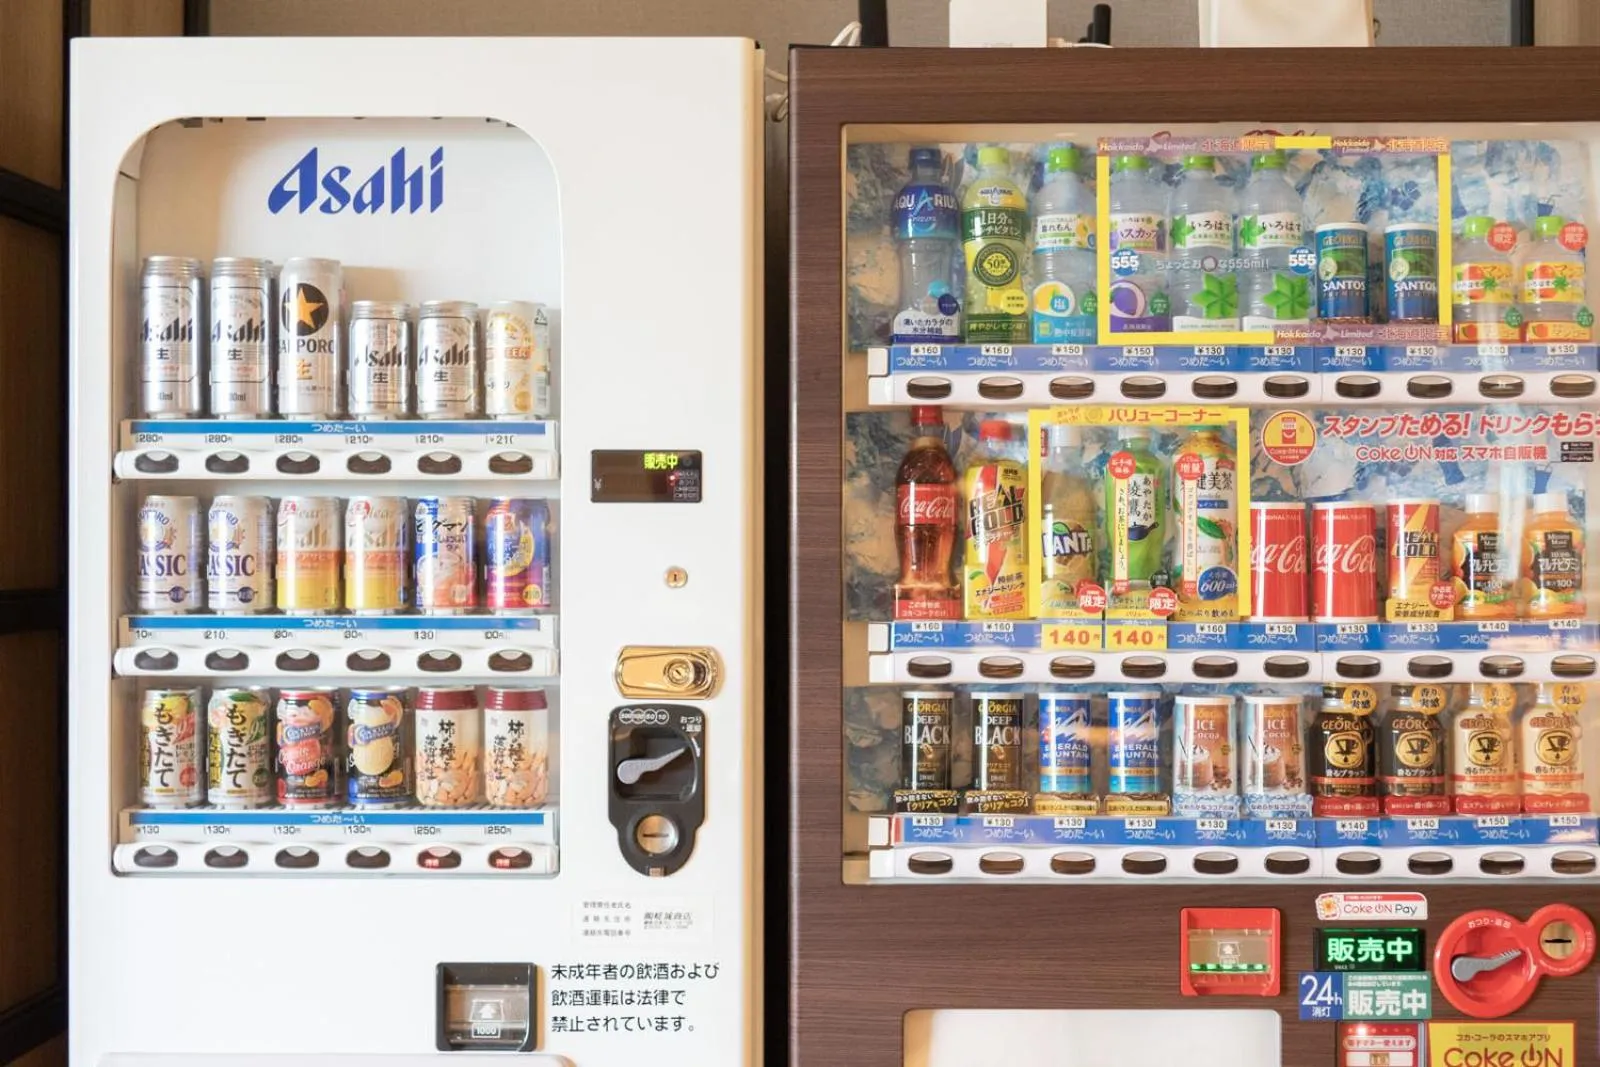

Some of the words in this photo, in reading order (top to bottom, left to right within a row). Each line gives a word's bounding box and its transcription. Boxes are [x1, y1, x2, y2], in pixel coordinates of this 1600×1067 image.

[267, 145, 444, 215] Asahi
[895, 190, 957, 213] QUARIU
[1111, 255, 1140, 269] 555
[1288, 254, 1317, 267] 555
[1322, 281, 1366, 292] SANTOS
[1276, 330, 1320, 339] Hokkaido
[1055, 346, 1080, 354] ¥150
[1126, 347, 1151, 355] ¥150
[1197, 347, 1223, 355] ¥130
[1267, 347, 1292, 355] ¥130
[1338, 347, 1363, 355] ¥130
[1409, 347, 1434, 355] ¥130
[1551, 345, 1576, 353] ¥130
[373, 372, 388, 384] 生
[434, 370, 449, 382] 生
[1107, 407, 1222, 423] バリューコーナー
[1323, 413, 1470, 437] スタンプためる!
[1356, 446, 1400, 461] Coke
[1405, 446, 1431, 461] ON
[1434, 447, 1456, 461] 対応
[1462, 446, 1548, 461] スマホ自販機
[644, 453, 678, 469] 販売中
[1142, 475, 1153, 522] あやたか
[976, 583, 1025, 597] エナジードリンク
[1080, 594, 1105, 607] 限定
[1150, 596, 1174, 609] 限定
[1178, 607, 1235, 618] たっぷり飲める
[1199, 625, 1224, 633] ¥160
[1268, 625, 1293, 633] ¥130
[1340, 625, 1365, 633] ¥130
[1410, 623, 1435, 631] ¥130
[1481, 623, 1506, 631] ¥140
[1553, 620, 1578, 628] ¥140
[681, 716, 701, 724] おつり
[1196, 720, 1216, 731] ICE
[1267, 720, 1287, 731] ICE
[905, 725, 950, 745] BLACK
[975, 725, 1020, 745] BLACK
[154, 703, 175, 788] もぎたて
[226, 703, 247, 788] もぎたて
[916, 818, 940, 826] ¥130
[1341, 822, 1365, 830] ¥140
[1411, 820, 1435, 828] ¥140
[1481, 818, 1506, 826] ¥150
[1553, 817, 1578, 825] ¥150
[1344, 904, 1373, 914] Coke
[1375, 903, 1393, 914] ON
[1395, 904, 1418, 916] Pay
[1327, 937, 1413, 963] 販売中
[551, 963, 720, 981] 未成年者の飲酒および
[1301, 975, 1343, 1006] 24h
[551, 989, 686, 1007] 飲酒運転は法律で
[1347, 988, 1427, 1016] 販売中
[1312, 1006, 1331, 1018] 消灯
[551, 1016, 695, 1033] 禁止されています。
[476, 1026, 497, 1036] 1000
